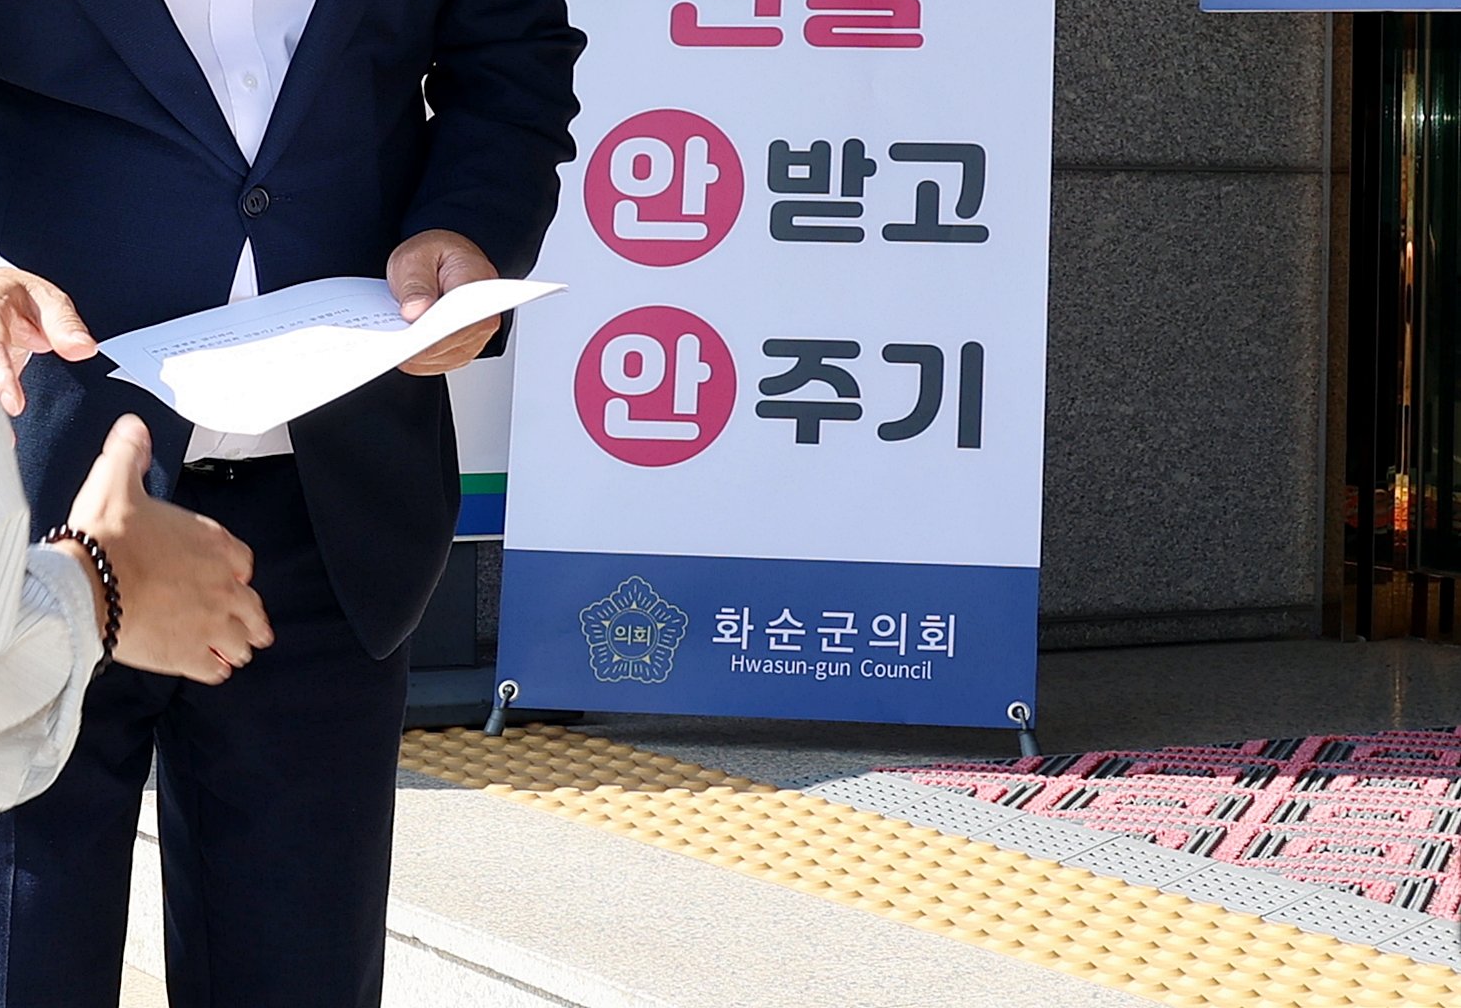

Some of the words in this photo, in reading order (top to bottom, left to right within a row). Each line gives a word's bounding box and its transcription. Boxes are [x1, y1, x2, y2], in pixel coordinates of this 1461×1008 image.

[609, 135, 720, 241] 안
[767, 138, 989, 243] 받고
[600, 333, 712, 441] 안
[755, 338, 985, 450] 주기
[614, 624, 651, 647] 의회
[712, 606, 956, 657] 화순군의회
[730, 654, 851, 681] Hwasun-gun
[860, 659, 932, 681] Council
